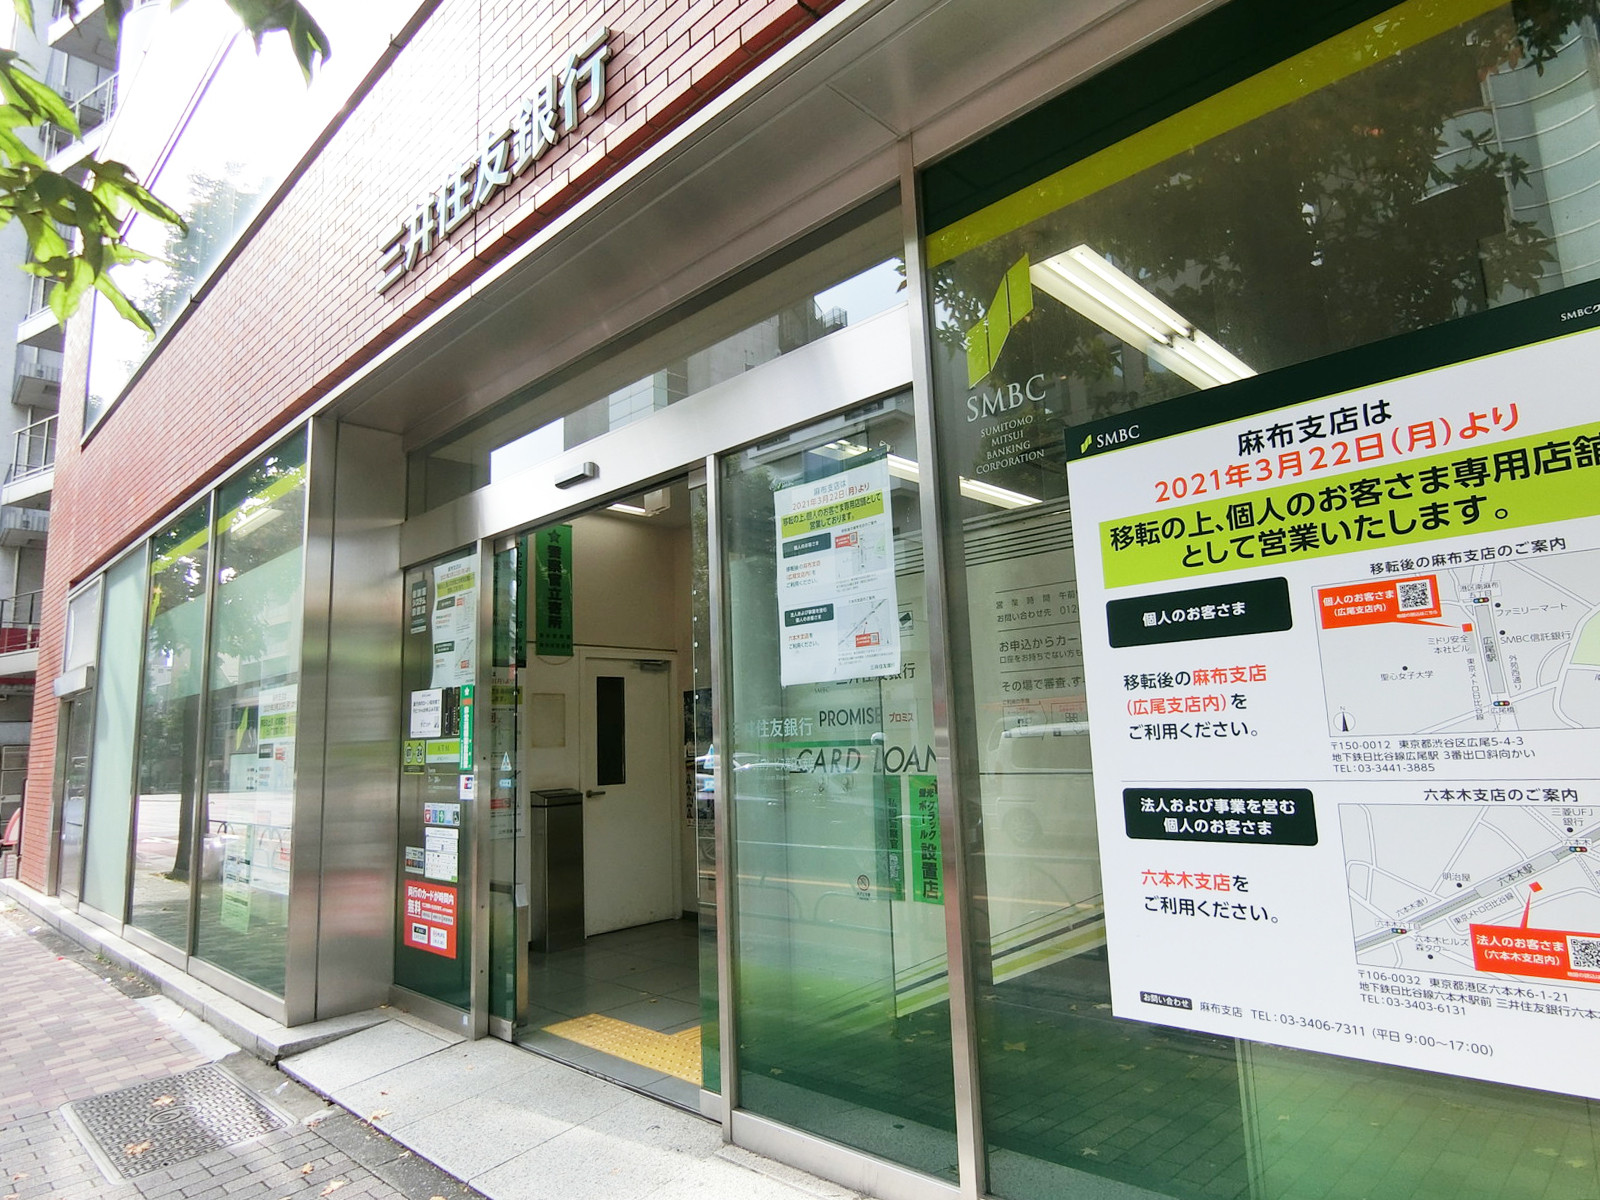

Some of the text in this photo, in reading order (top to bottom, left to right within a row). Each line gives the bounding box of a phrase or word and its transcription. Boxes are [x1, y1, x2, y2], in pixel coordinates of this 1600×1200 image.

[376, 25, 614, 295] 三井住友銀行
[966, 373, 1047, 422] SMBC
[980, 415, 1034, 438] SUMITOMO
[1096, 424, 1140, 448] SMBC
[1237, 399, 1393, 457] 麻布支店は
[991, 430, 1024, 447] MITSUI
[976, 448, 1046, 475] CORPORATION
[986, 440, 1031, 461] BANKING
[1181, 493, 1509, 569] として営業いたします。
[1369, 537, 1567, 575] 移転後の麻布支店のご案内
[1323, 589, 1395, 607] 個人のお客さま
[1142, 601, 1247, 628] 個人のお客さま
[1123, 664, 1268, 692] 移転後の麻布支店
[819, 706, 881, 728] PROMISE
[888, 711, 914, 723] プロミス
[1128, 721, 1259, 741] ご利用ください。
[1398, 737, 1525, 750] 東京都渋谷区広尾5-4-3
[1423, 787, 1579, 803] 六本木支店のご案内
[1139, 797, 1296, 816] 法人および事業を営む
[1163, 817, 1273, 836] 個人のお客さま
[1140, 869, 1250, 893] 六本木支店を
[1143, 894, 1279, 924] ご利用ください。
[1475, 933, 1565, 952] 法人のお客さま
[1428, 977, 1569, 1003] 東京都港区六本木6-1-21
[1199, 1001, 1243, 1019] 麻布支店
[1495, 998, 1600, 1020] 三井住友銀行六本
